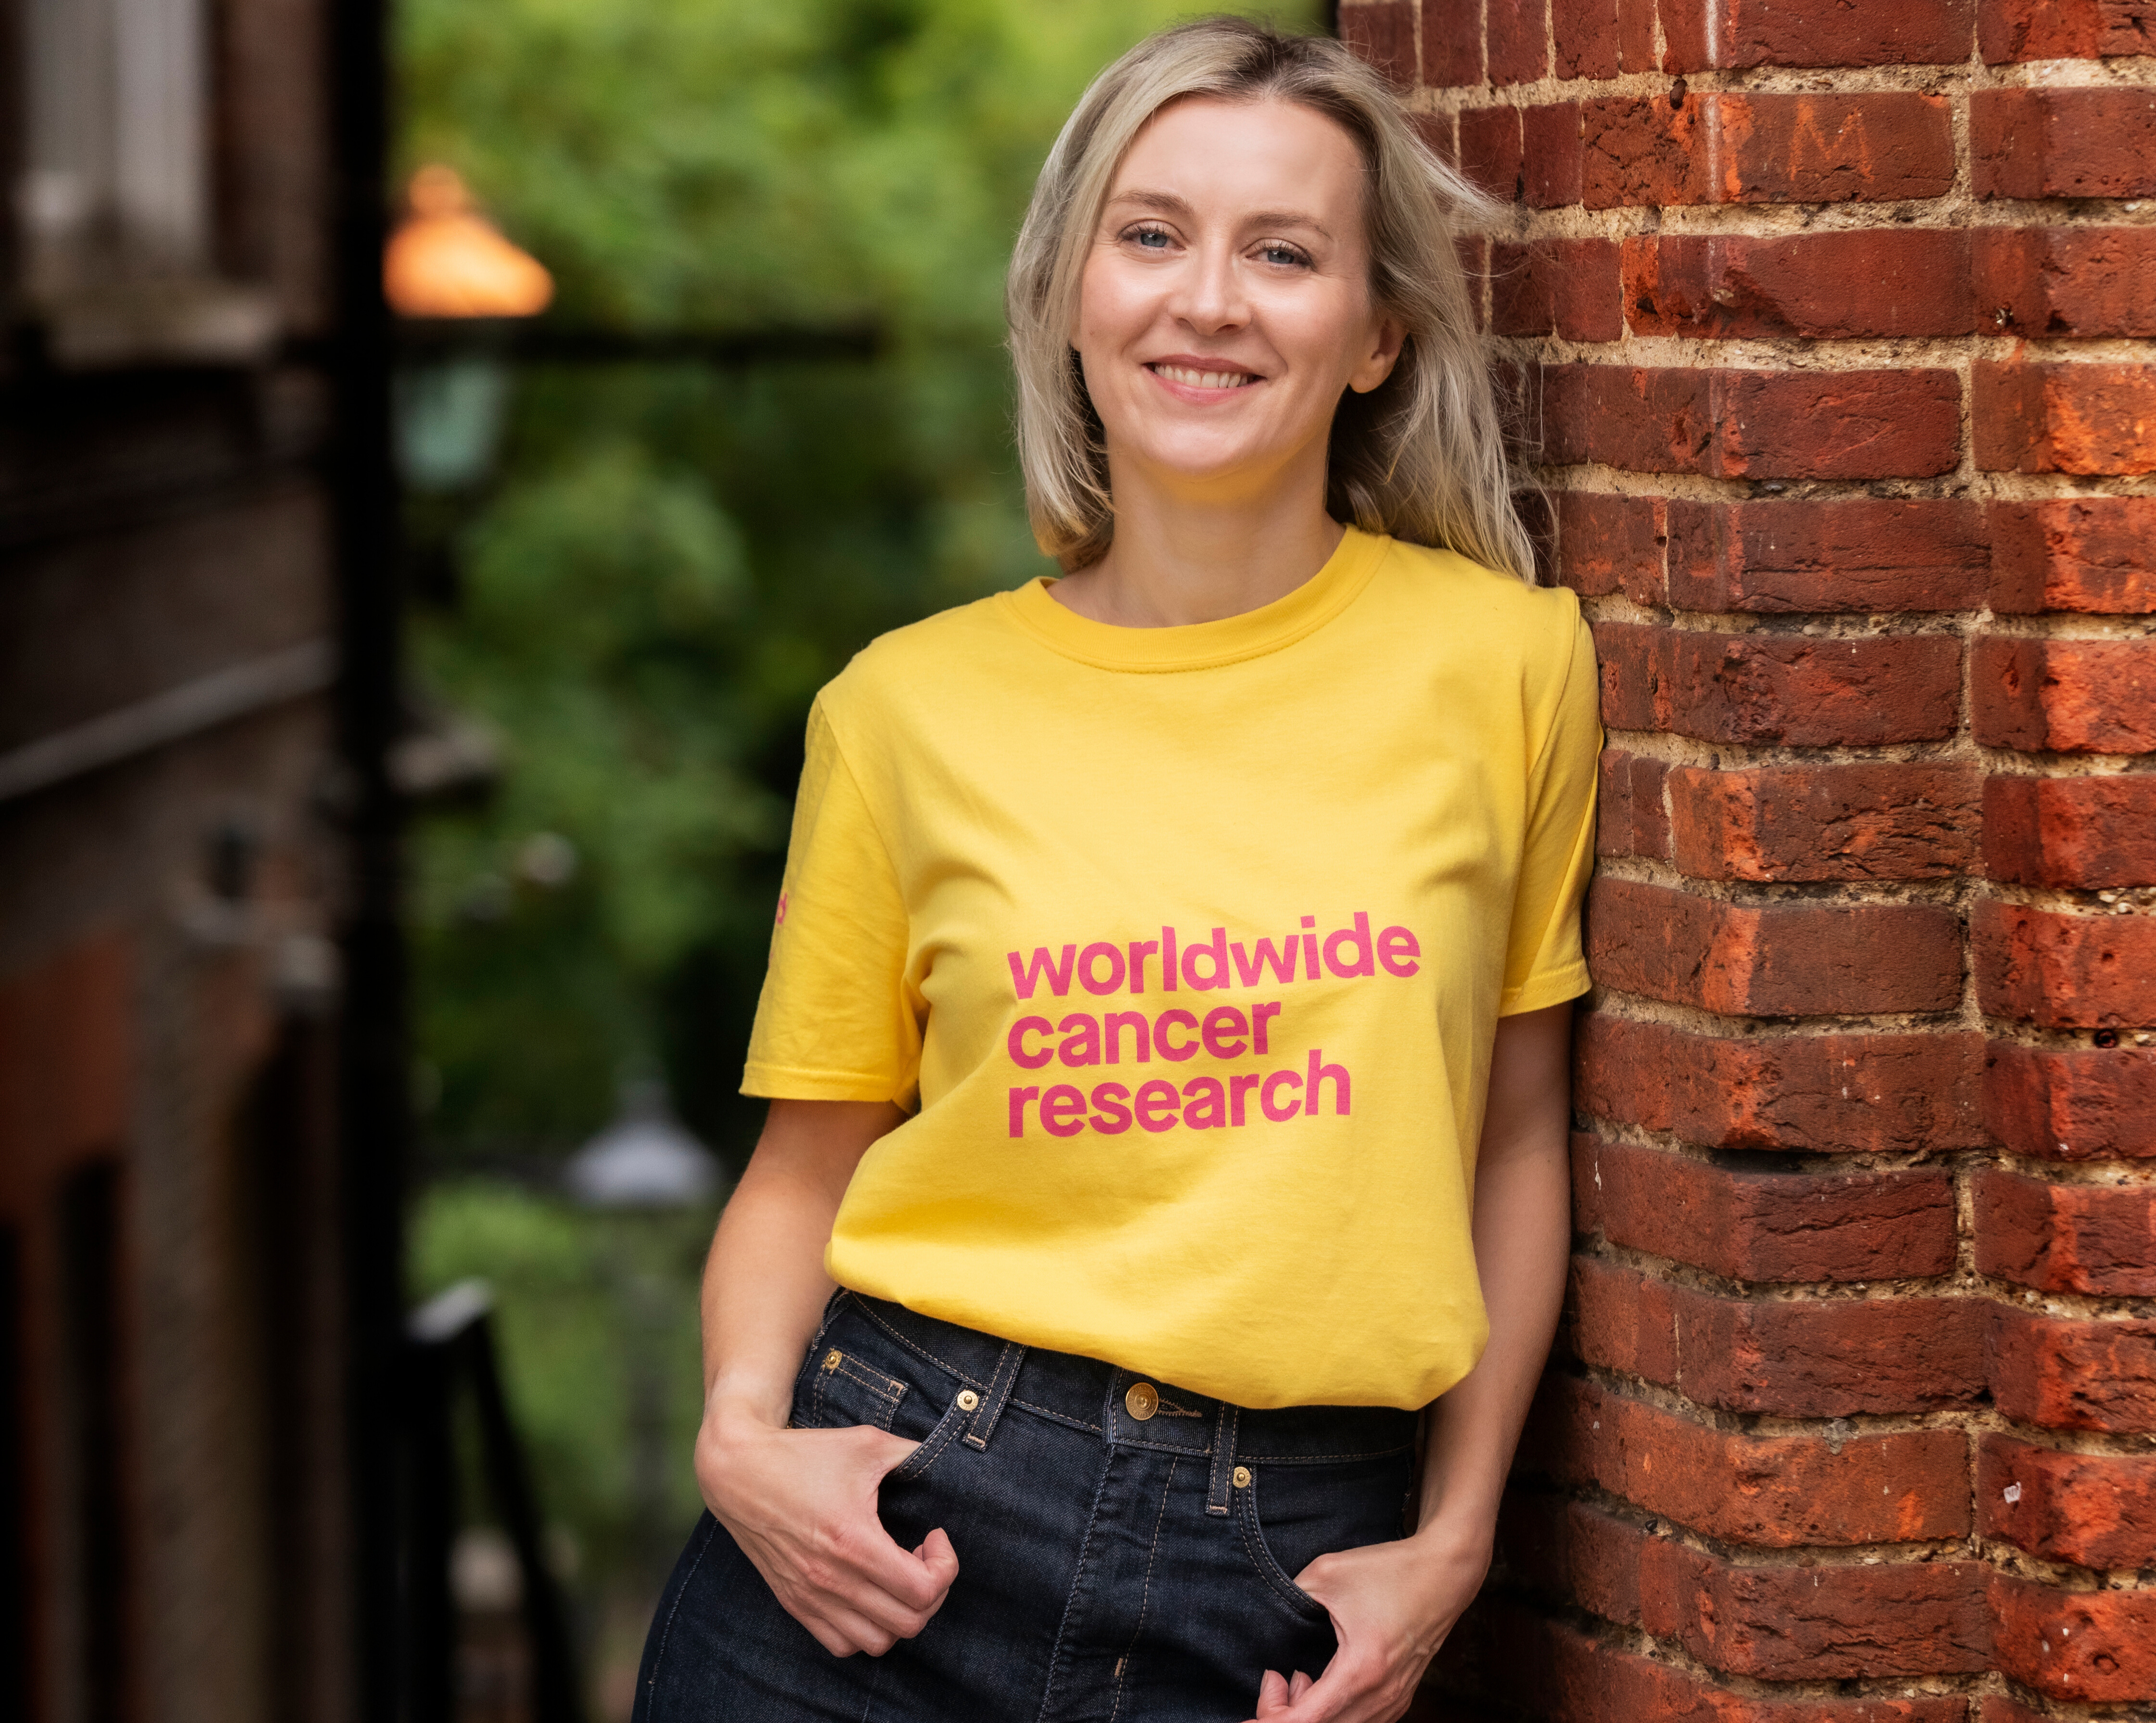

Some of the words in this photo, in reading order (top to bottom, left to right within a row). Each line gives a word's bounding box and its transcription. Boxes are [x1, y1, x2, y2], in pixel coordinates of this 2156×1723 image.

[1007, 911, 1421, 999] worldwide
[1007, 1001, 1281, 1069] cancer
[1009, 1049, 1351, 1138] research
